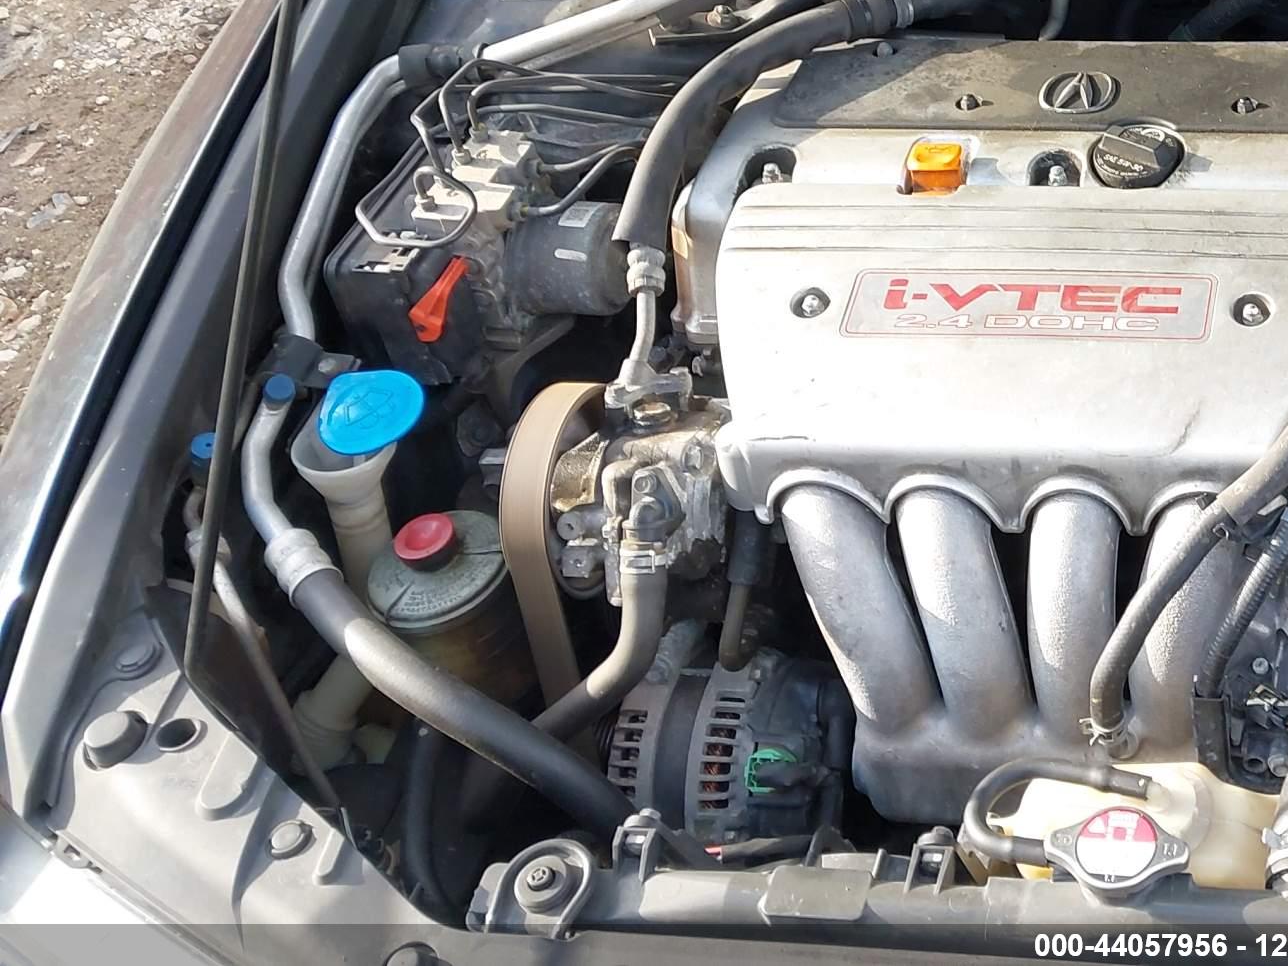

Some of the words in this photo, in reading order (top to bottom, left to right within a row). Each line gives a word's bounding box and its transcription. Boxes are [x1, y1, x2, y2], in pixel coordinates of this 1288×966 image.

[883, 278, 1182, 315] i-VTEC
[893, 314, 974, 330] 2.4
[984, 314, 1161, 332] DOHC
